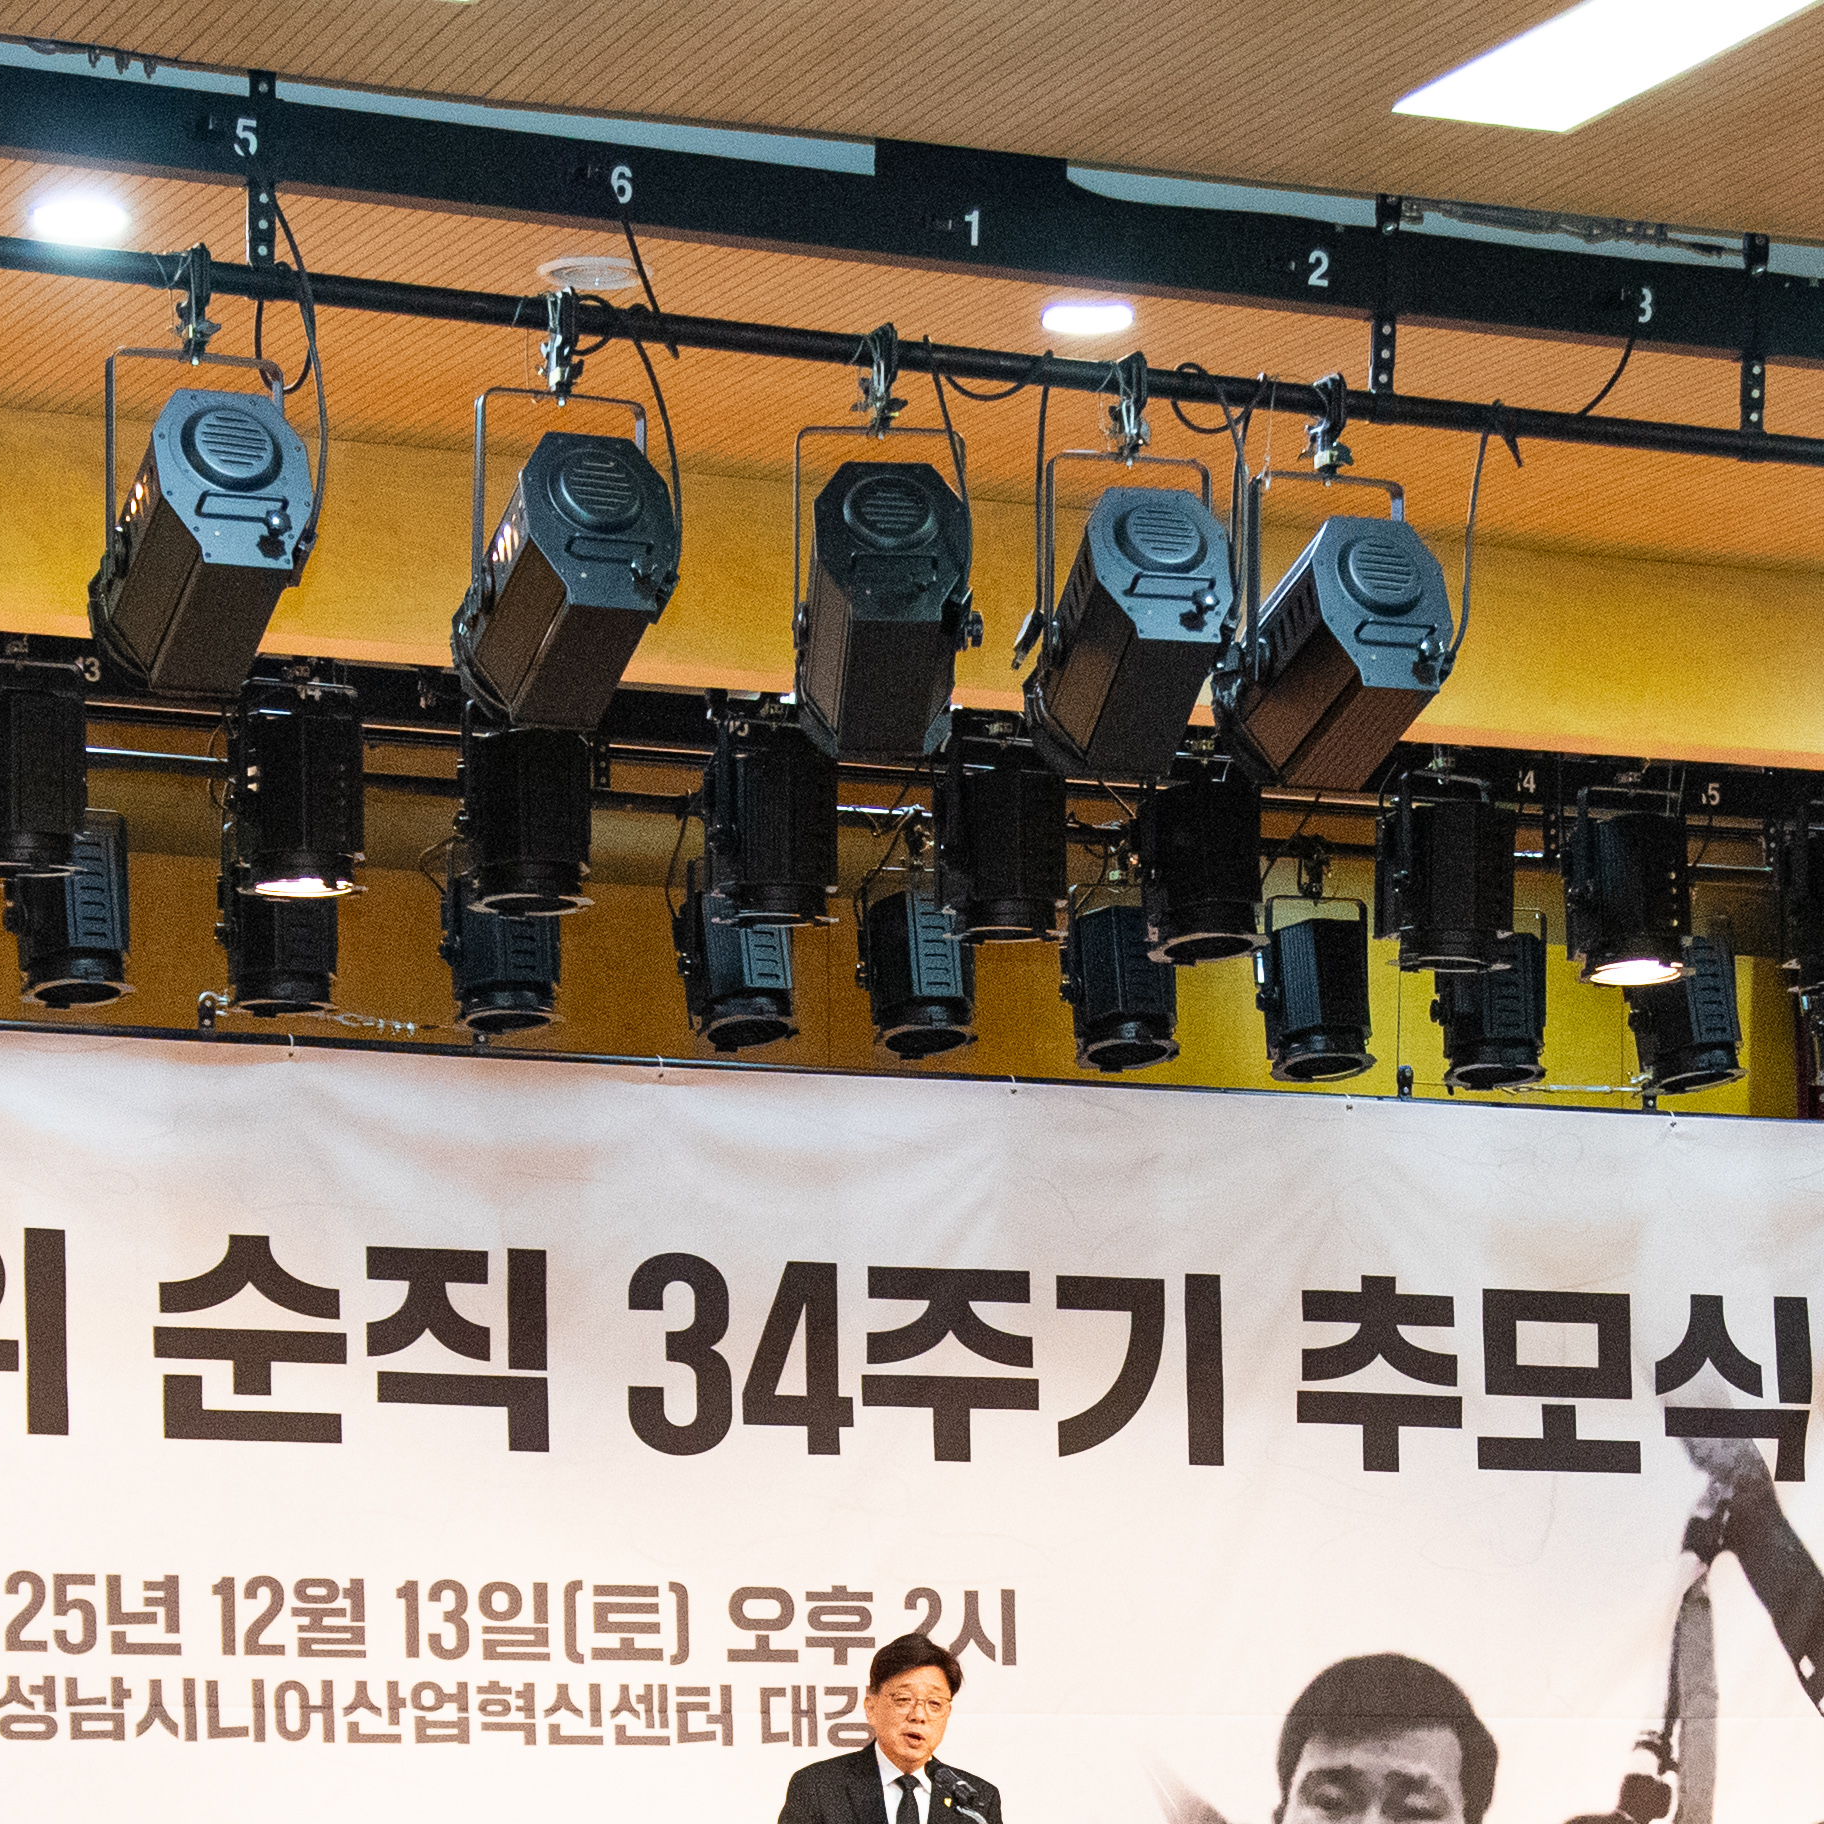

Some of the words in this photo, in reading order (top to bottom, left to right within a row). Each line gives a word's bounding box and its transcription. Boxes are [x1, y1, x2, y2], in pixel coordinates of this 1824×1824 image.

[233, 116, 259, 157] 5
[610, 164, 634, 205] 6
[964, 209, 980, 247] 1
[1307, 249, 1331, 288] 2
[1637, 286, 1653, 324] 3
[153, 1233, 551, 1453] 순직
[626, 1252, 1225, 1467] 34주기
[1296, 1274, 1813, 1482] 추모식
[212, 1575, 367, 1659] 12월
[396, 1578, 690, 1666] 13일(토)
[727, 1585, 875, 1666] 오후
[903, 1586, 1017, 1666] 2시
[759, 1683, 877, 1749] 대강
